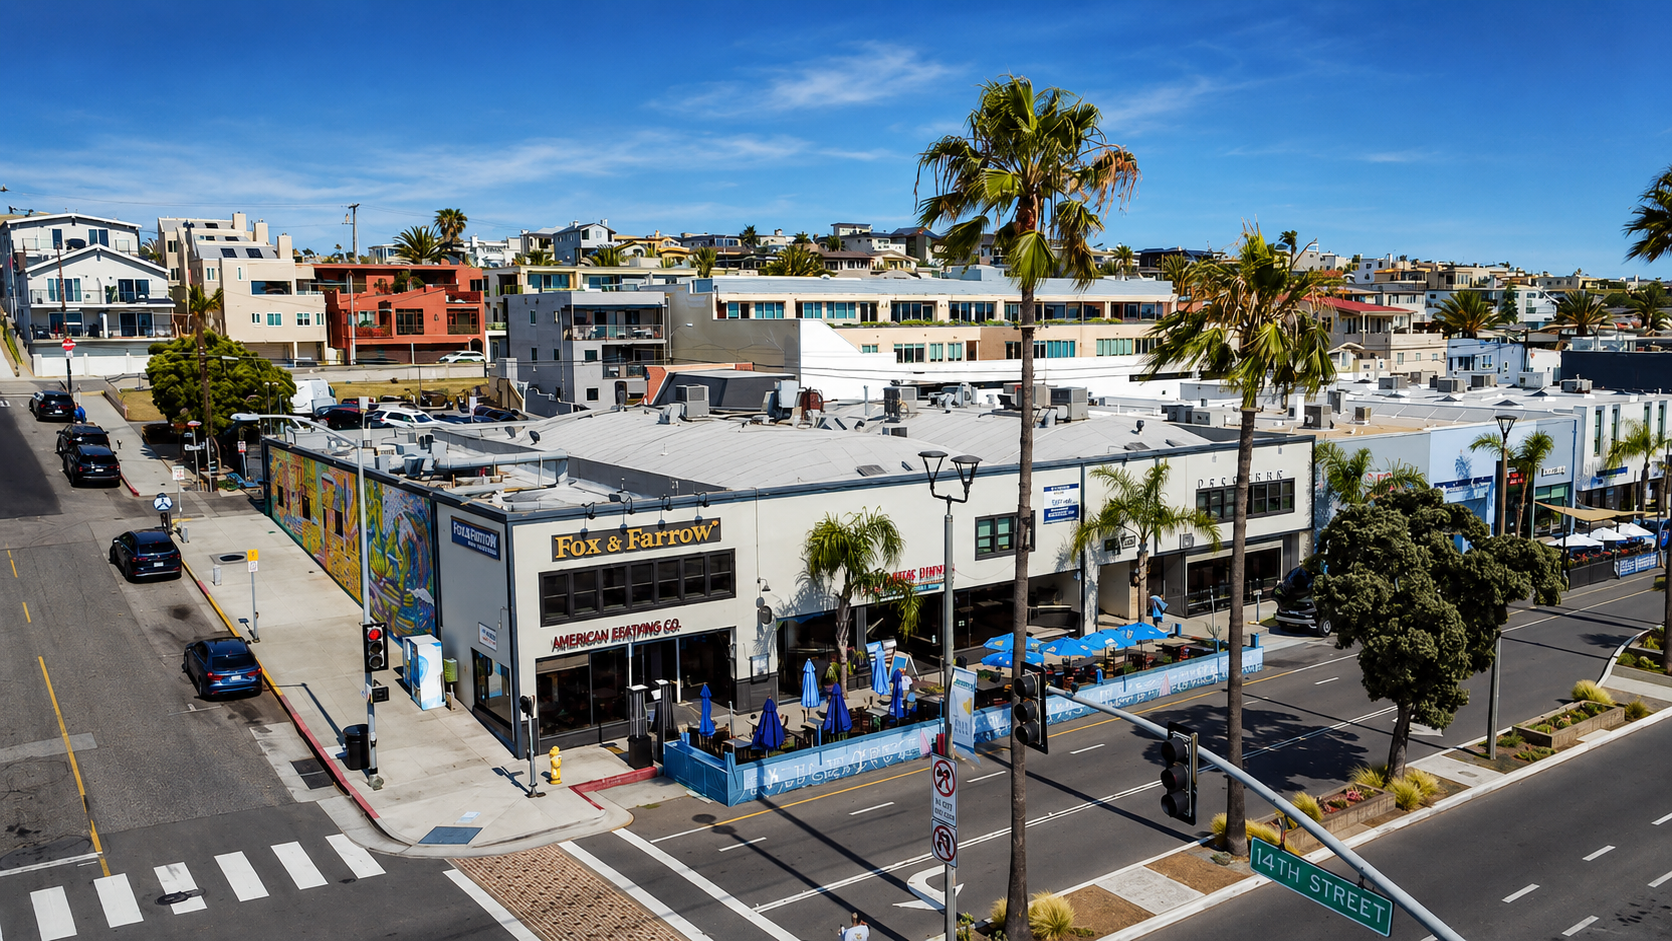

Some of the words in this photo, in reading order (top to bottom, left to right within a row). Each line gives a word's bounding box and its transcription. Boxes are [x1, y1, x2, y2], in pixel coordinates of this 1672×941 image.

[555, 535, 602, 559] Fox
[606, 535, 622, 553] &
[626, 522, 716, 551] Farrow
[553, 628, 609, 648] AMERICAN
[663, 617, 682, 633] CO.
[1257, 848, 1300, 884] 14TH
[1309, 874, 1386, 924] STREET
